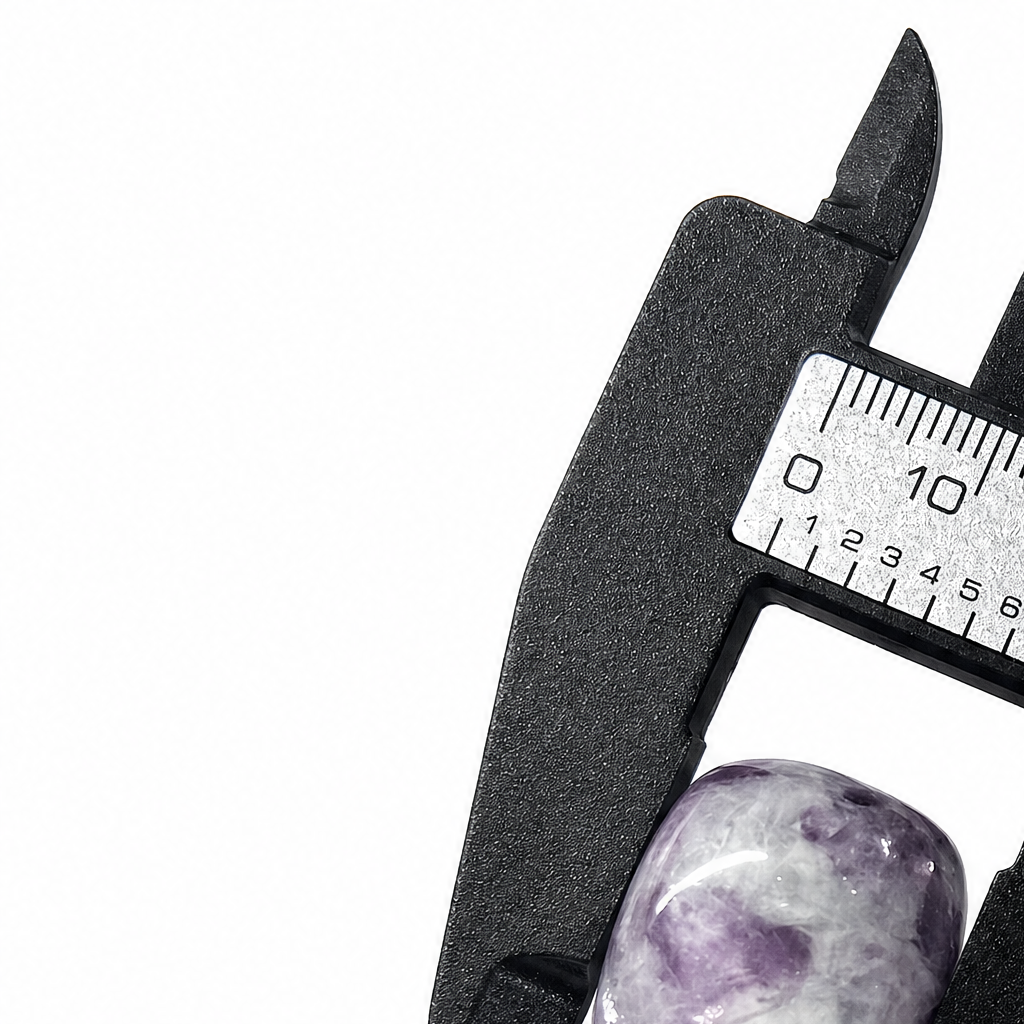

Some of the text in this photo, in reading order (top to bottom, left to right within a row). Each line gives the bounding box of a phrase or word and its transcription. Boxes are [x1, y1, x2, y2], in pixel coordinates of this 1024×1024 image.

[783, 453, 824, 494] 0
[907, 465, 967, 515] 10
[806, 515, 819, 535] 1
[839, 529, 864, 552] 2
[880, 545, 903, 568] 3
[919, 564, 942, 585] 4
[959, 577, 983, 601] 5
[999, 595, 1022, 619] 6
